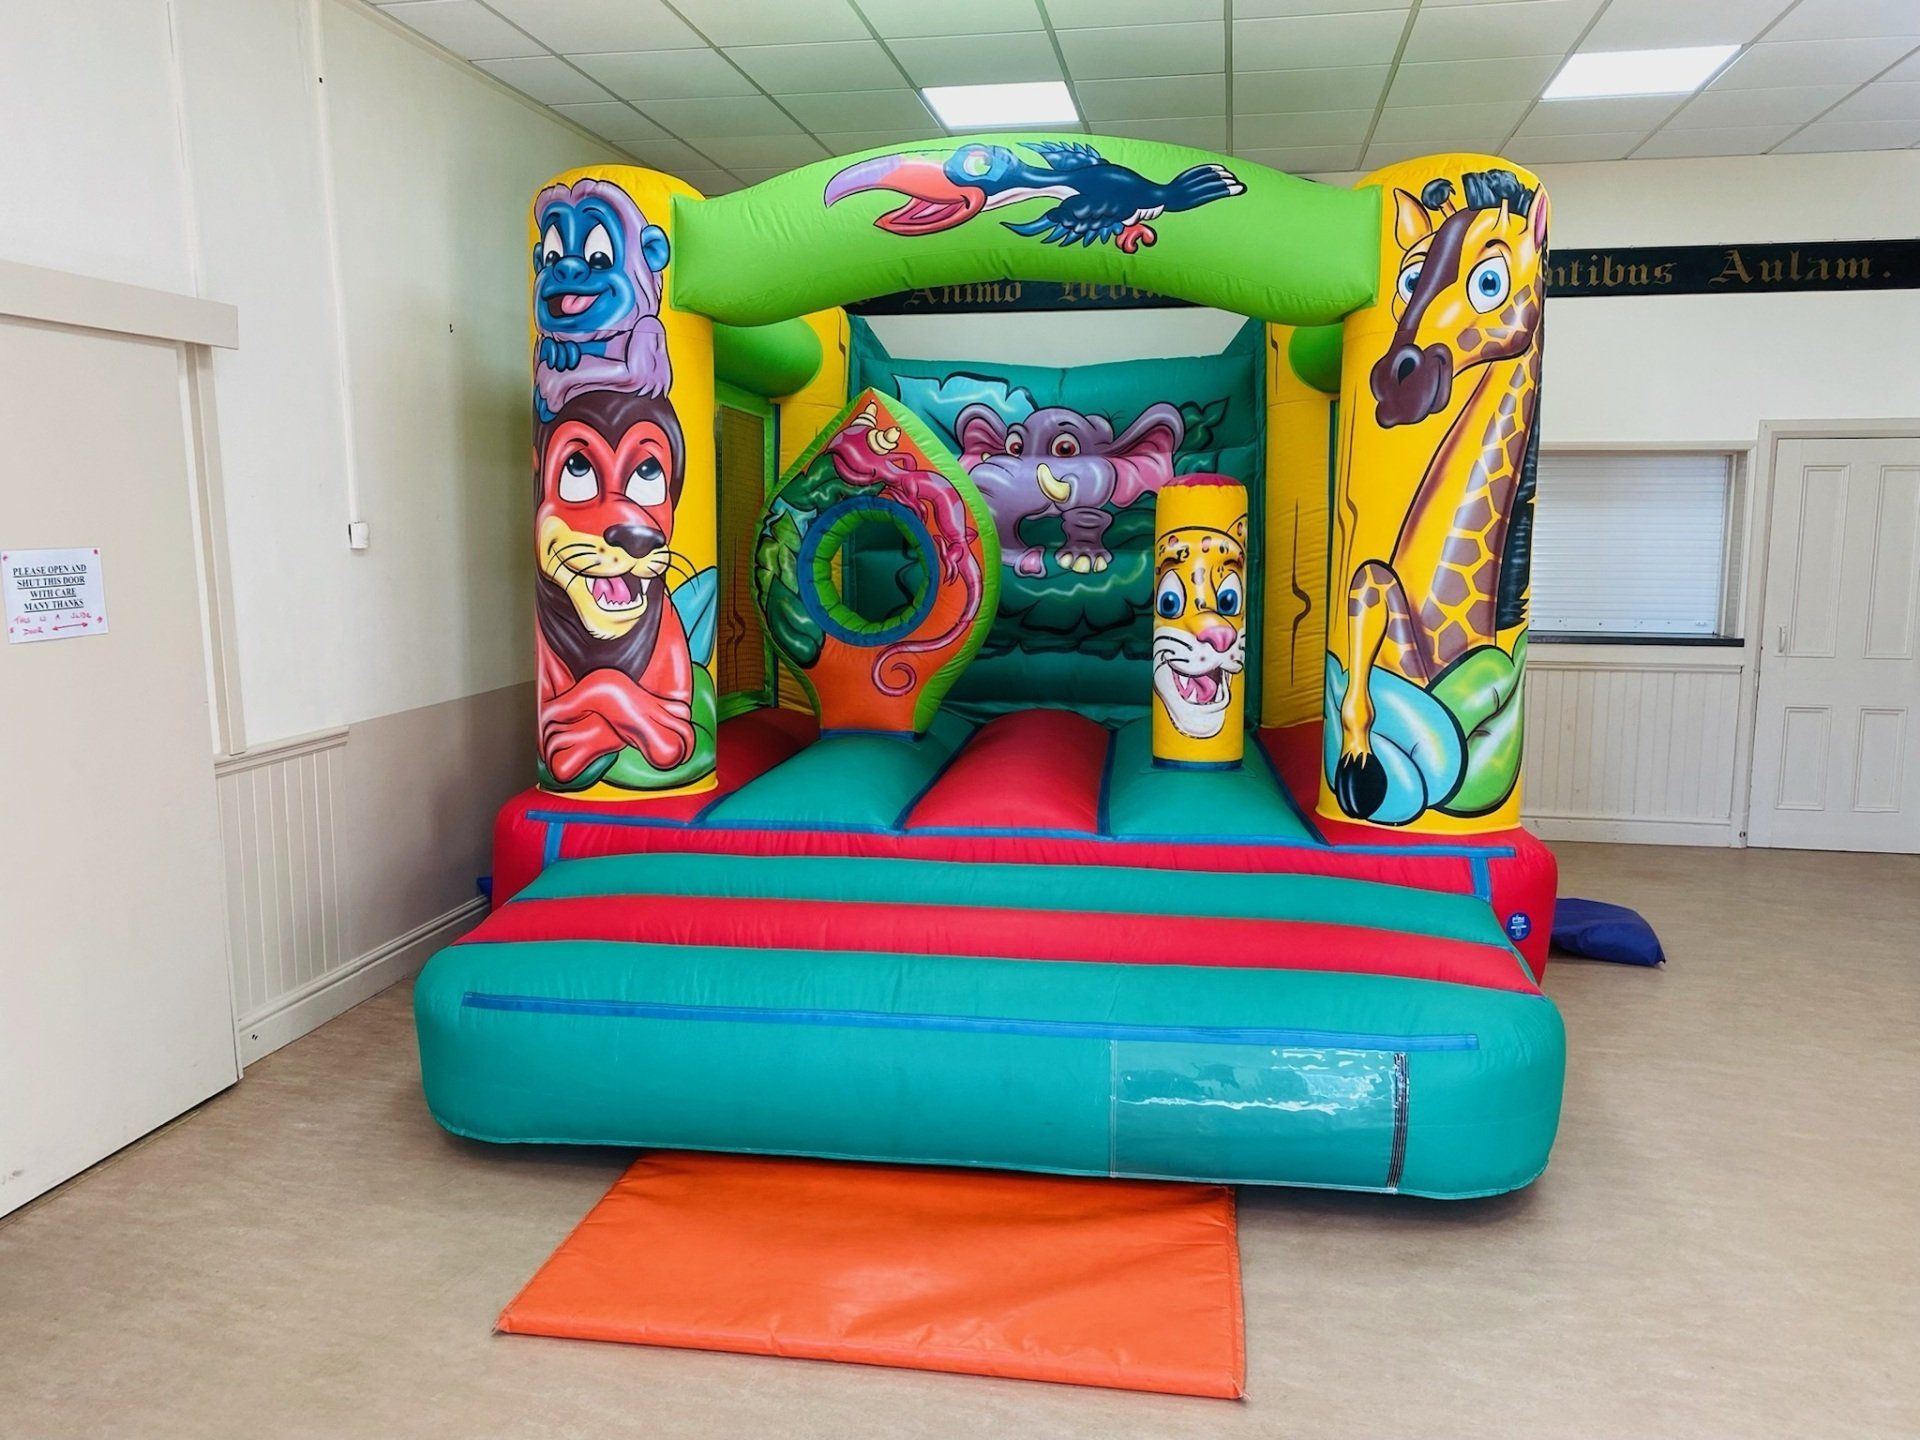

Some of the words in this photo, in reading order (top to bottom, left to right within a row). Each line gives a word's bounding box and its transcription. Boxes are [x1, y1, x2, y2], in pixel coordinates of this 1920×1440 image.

[1545, 254, 1678, 288] ntibus
[13, 566, 46, 576] PLEASE
[47, 565, 69, 574] OPEN
[72, 563, 87, 573] AND
[17, 578, 41, 588] SHUT
[43, 577, 62, 586] THIS
[63, 576, 86, 584] DOOR
[30, 588, 54, 598] WITH
[55, 587, 77, 597] CARE
[24, 601, 50, 611] MANY
[52, 599, 84, 609] THANKS
